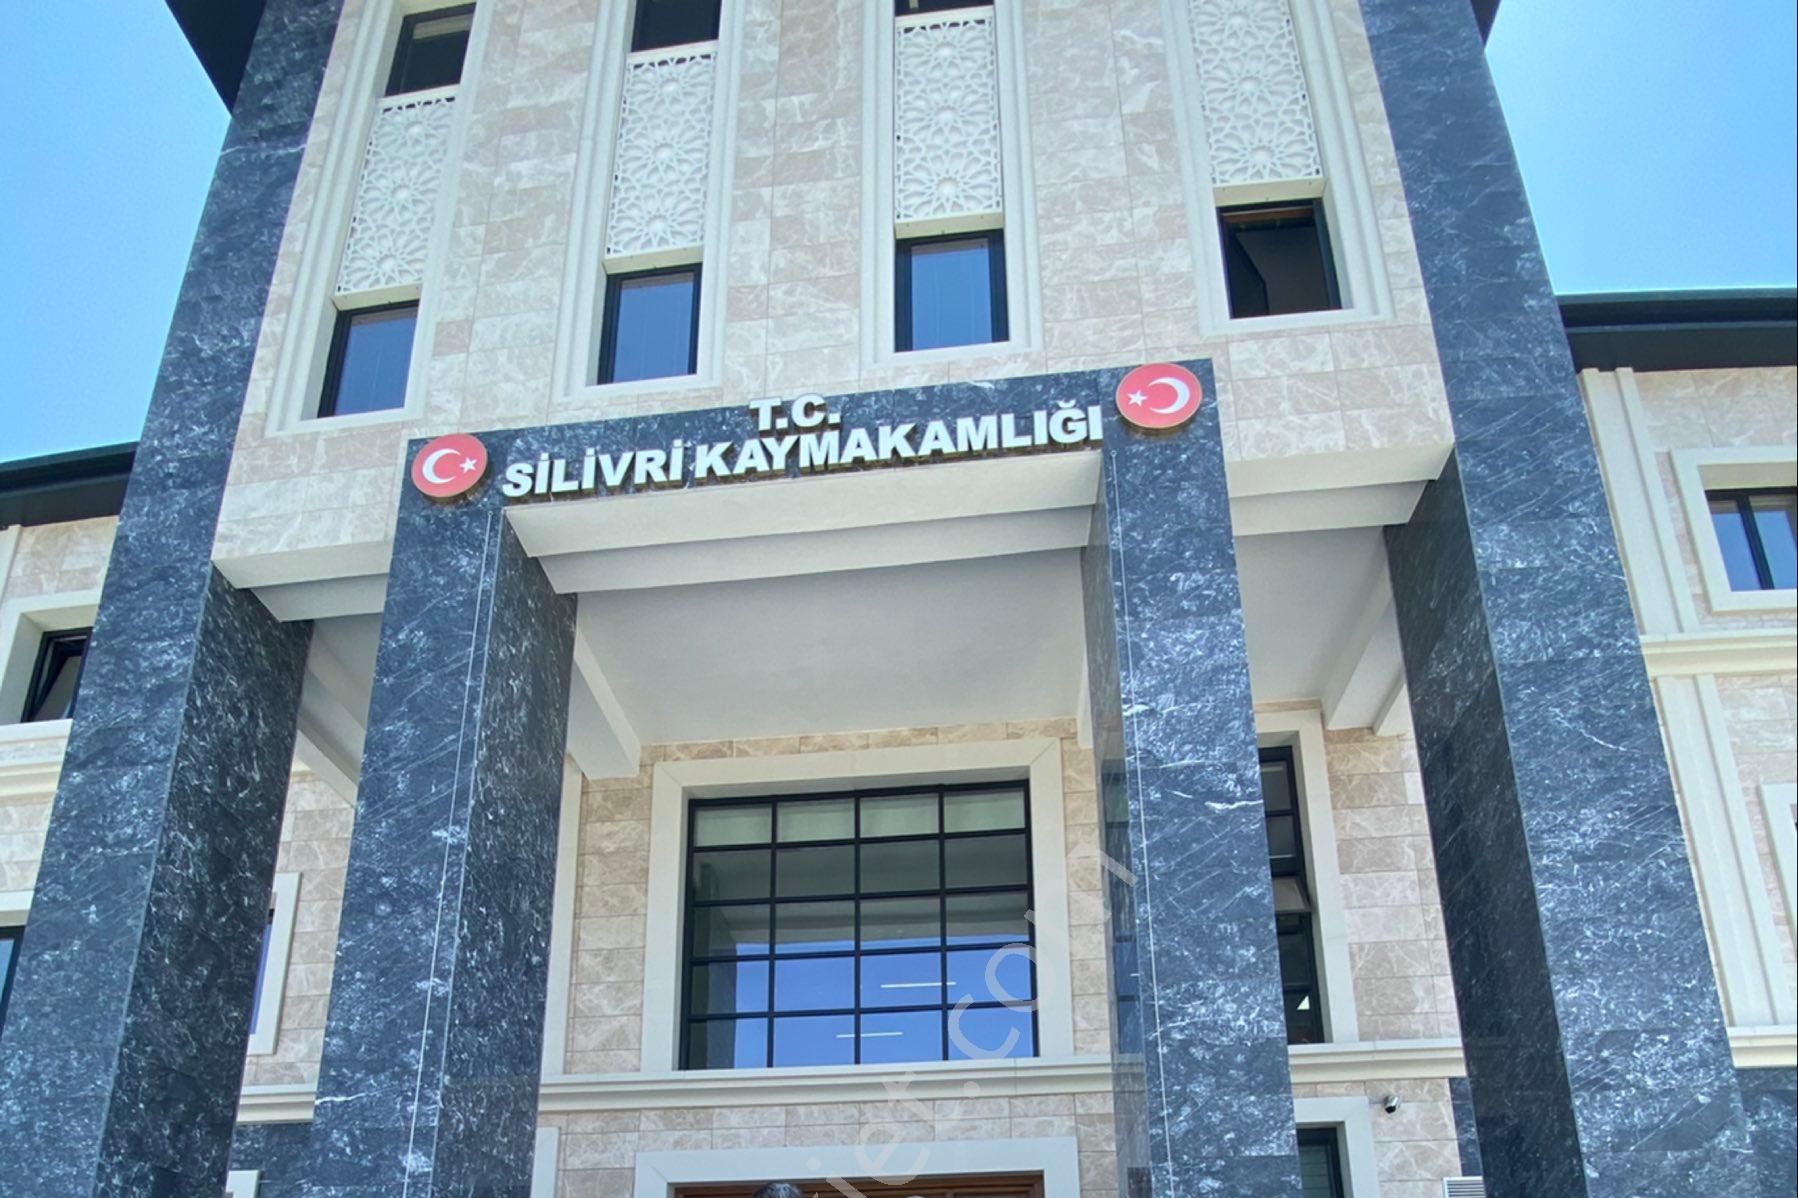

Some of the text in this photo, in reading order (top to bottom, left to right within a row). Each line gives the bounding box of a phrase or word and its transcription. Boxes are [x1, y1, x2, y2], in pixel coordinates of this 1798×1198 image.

[749, 394, 842, 432] T.C.
[502, 399, 1103, 498] SİLİVRİ KAYMAKAMLIĞI
